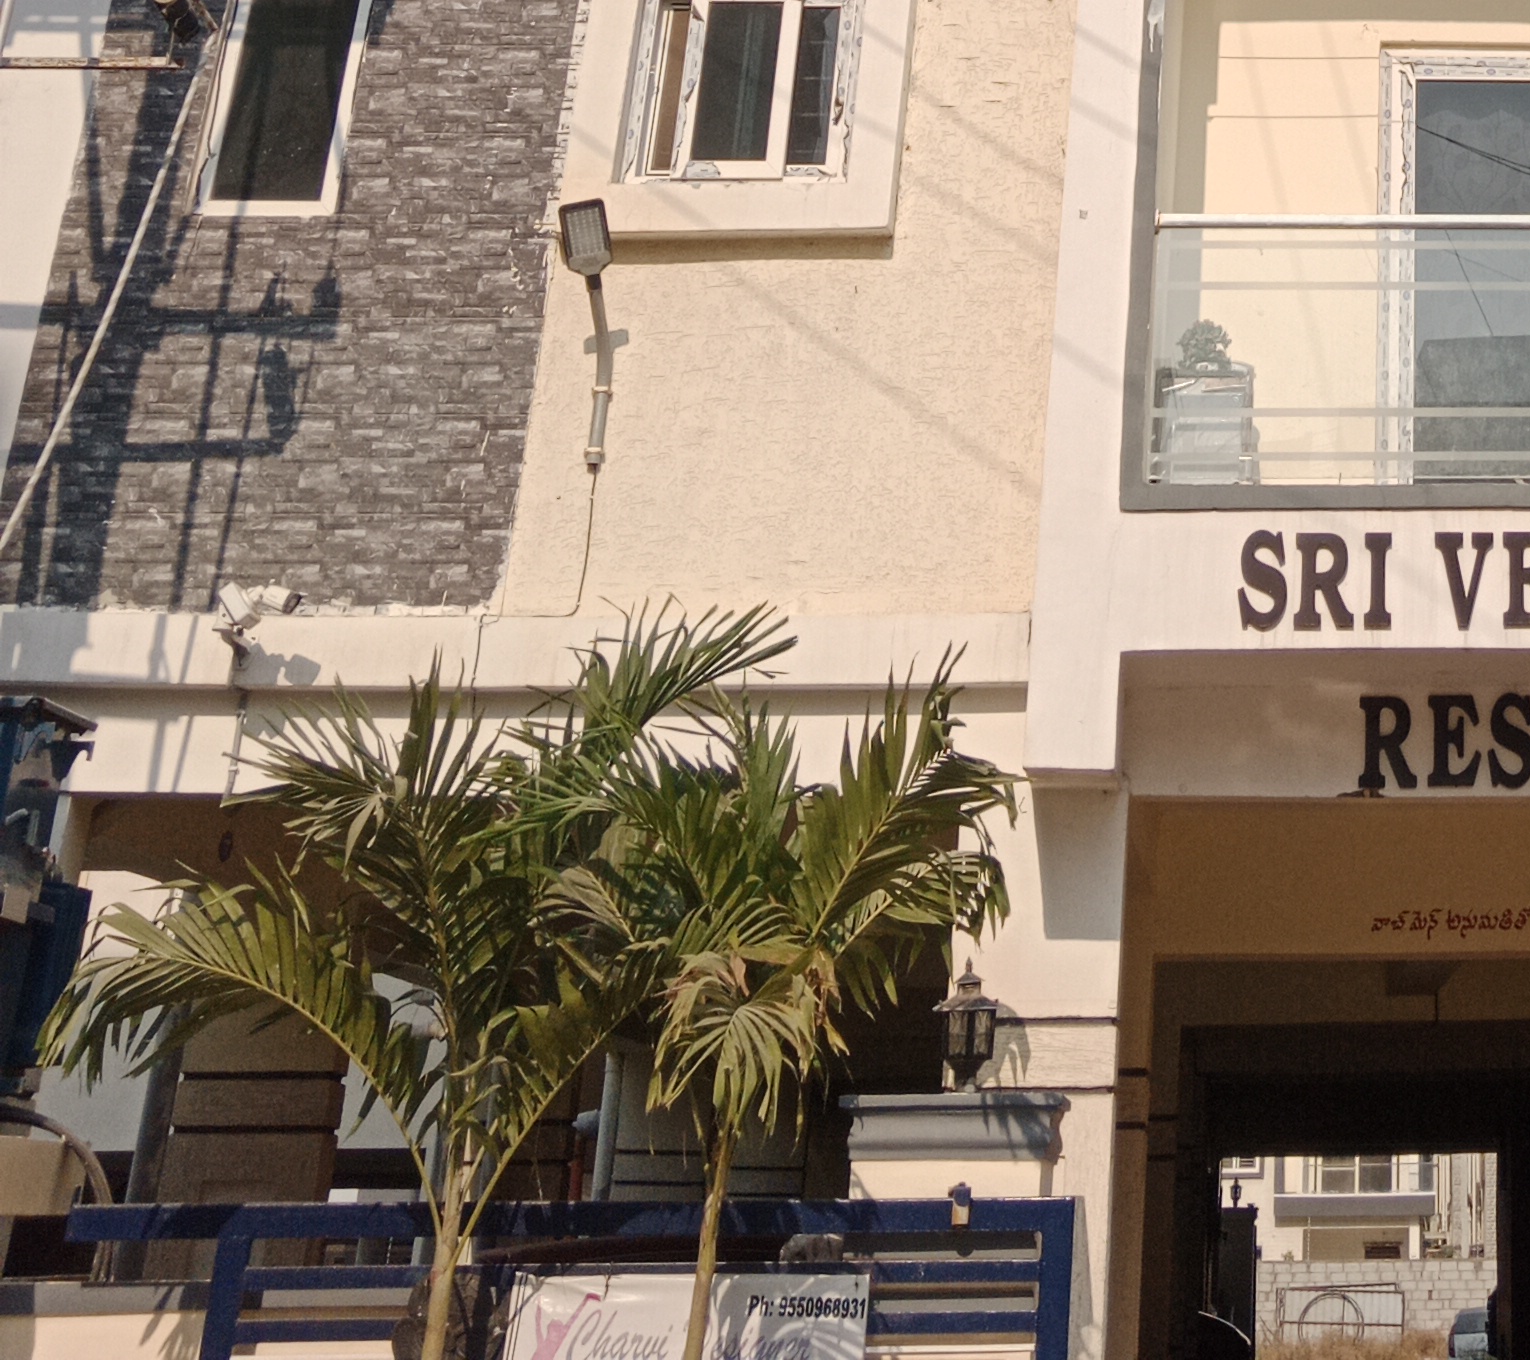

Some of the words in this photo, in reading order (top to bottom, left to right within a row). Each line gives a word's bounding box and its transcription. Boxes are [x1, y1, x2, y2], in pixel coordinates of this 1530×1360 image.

[1237, 529, 1393, 632] SRI
[747, 1294, 774, 1317] Ph:
[778, 1295, 866, 1319] 9550968931
